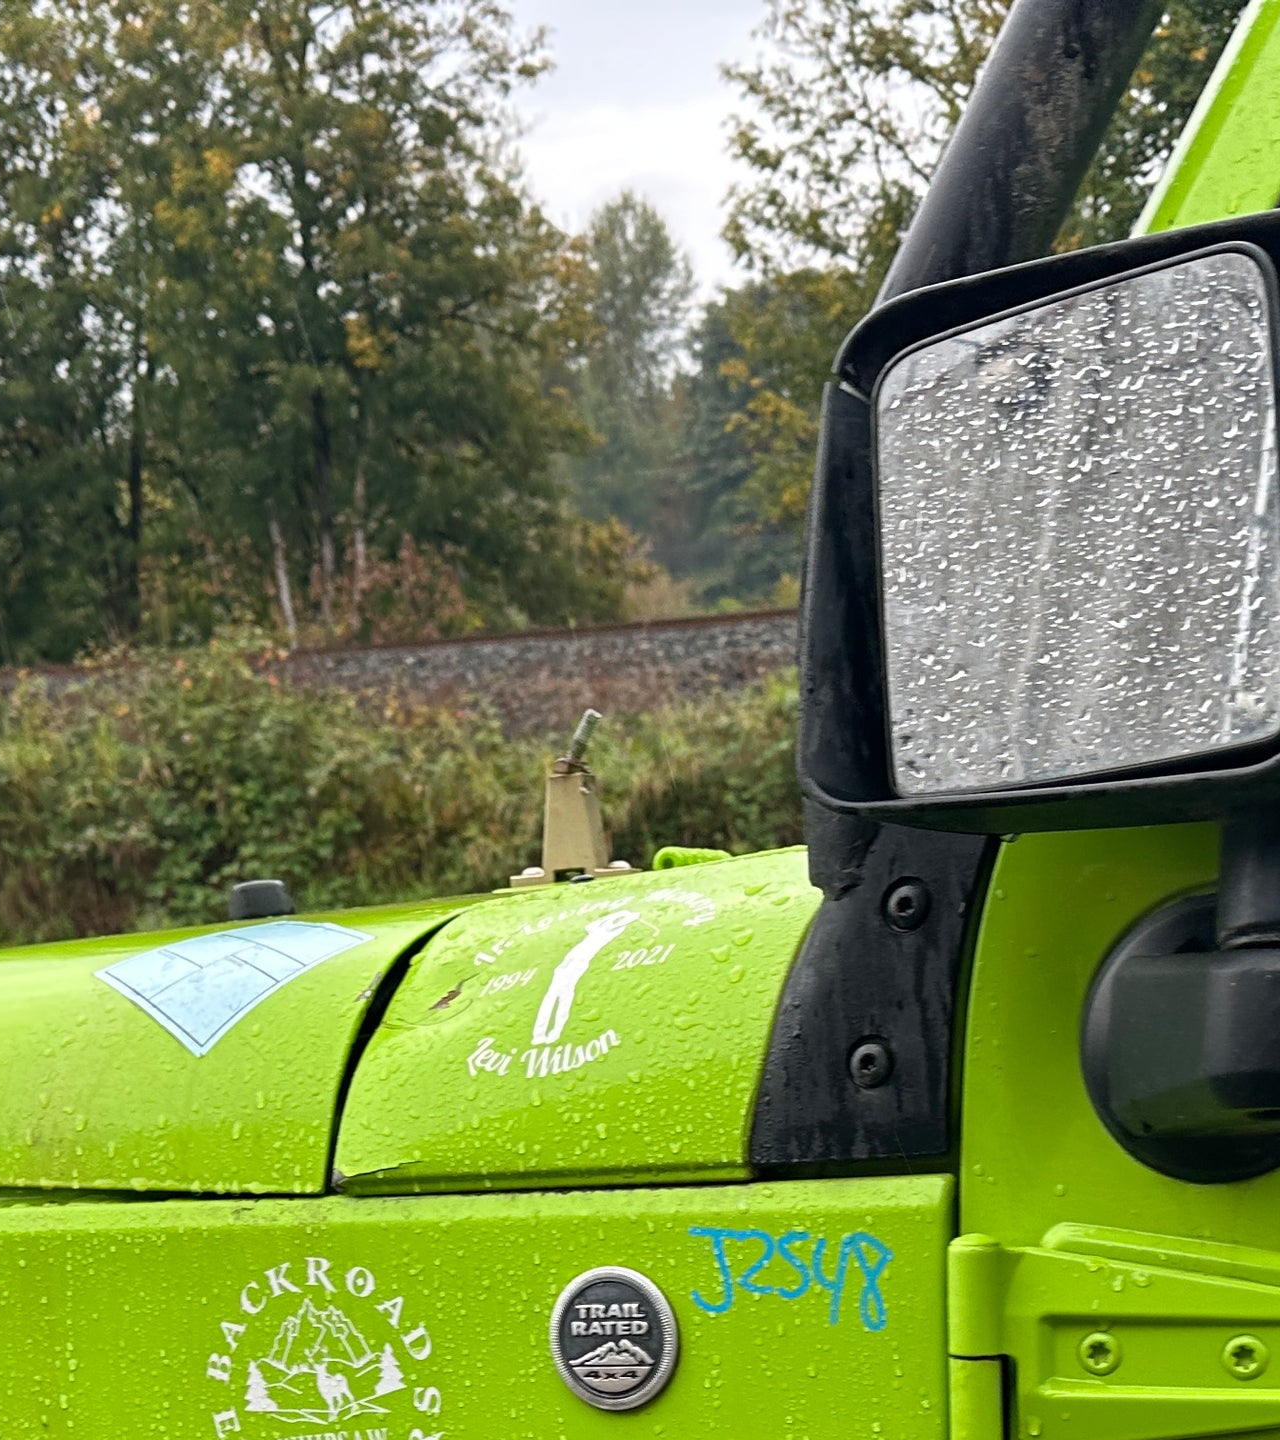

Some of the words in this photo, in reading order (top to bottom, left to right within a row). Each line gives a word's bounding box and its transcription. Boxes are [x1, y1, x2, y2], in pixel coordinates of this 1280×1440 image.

[611, 943, 676, 972] 2021
[479, 967, 538, 998] 1994
[520, 1029, 621, 1079] Wilson
[206, 1256, 433, 1384] BACKROAD
[575, 1303, 646, 1320] TRAIL
[571, 1321, 649, 1338] RATED
